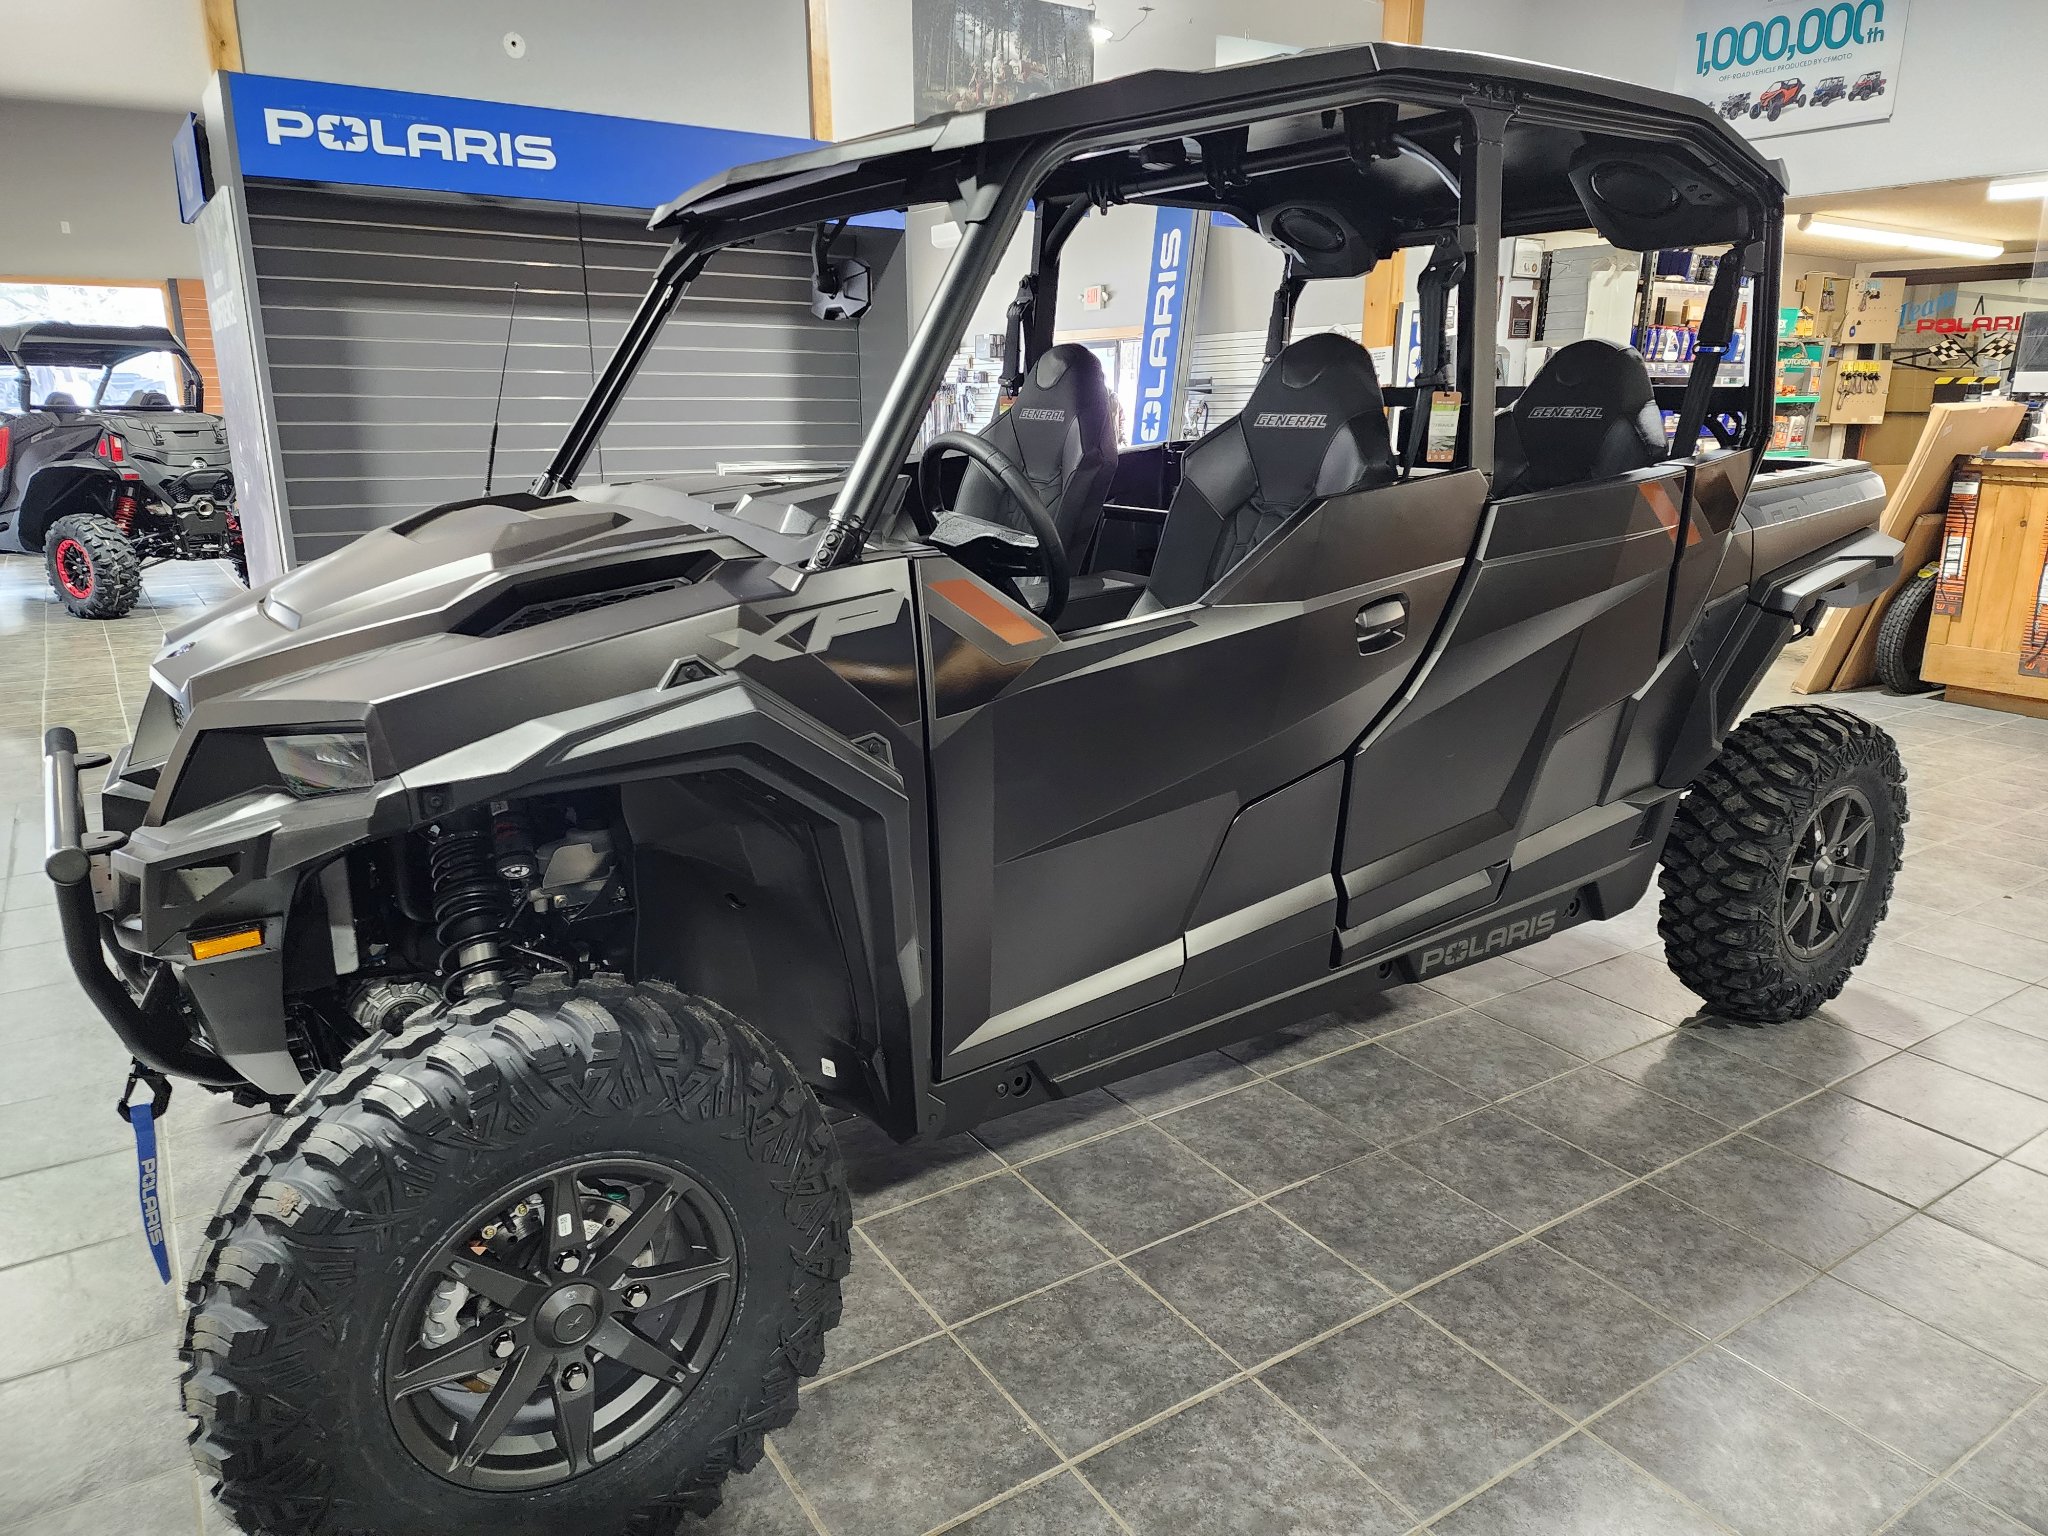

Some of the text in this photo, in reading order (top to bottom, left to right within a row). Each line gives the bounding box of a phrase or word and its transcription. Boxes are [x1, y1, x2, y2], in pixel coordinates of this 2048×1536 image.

[1718, 71, 1751, 82] OFF-ROAD
[1751, 66, 1776, 76] VEHICLE
[1777, 59, 1812, 72] PRODUCED
[1822, 52, 1853, 63] CFMOTO
[263, 107, 557, 170] POLARIS
[1140, 227, 1182, 442] OLARIS
[1916, 316, 2022, 334] POLARI
[1019, 408, 1065, 422] GENERAL
[1254, 413, 1327, 429] GENERAL
[1528, 406, 1603, 419] GENERAL
[1420, 910, 1557, 975] POLARIS
[141, 1157, 163, 1246] POLARIS
